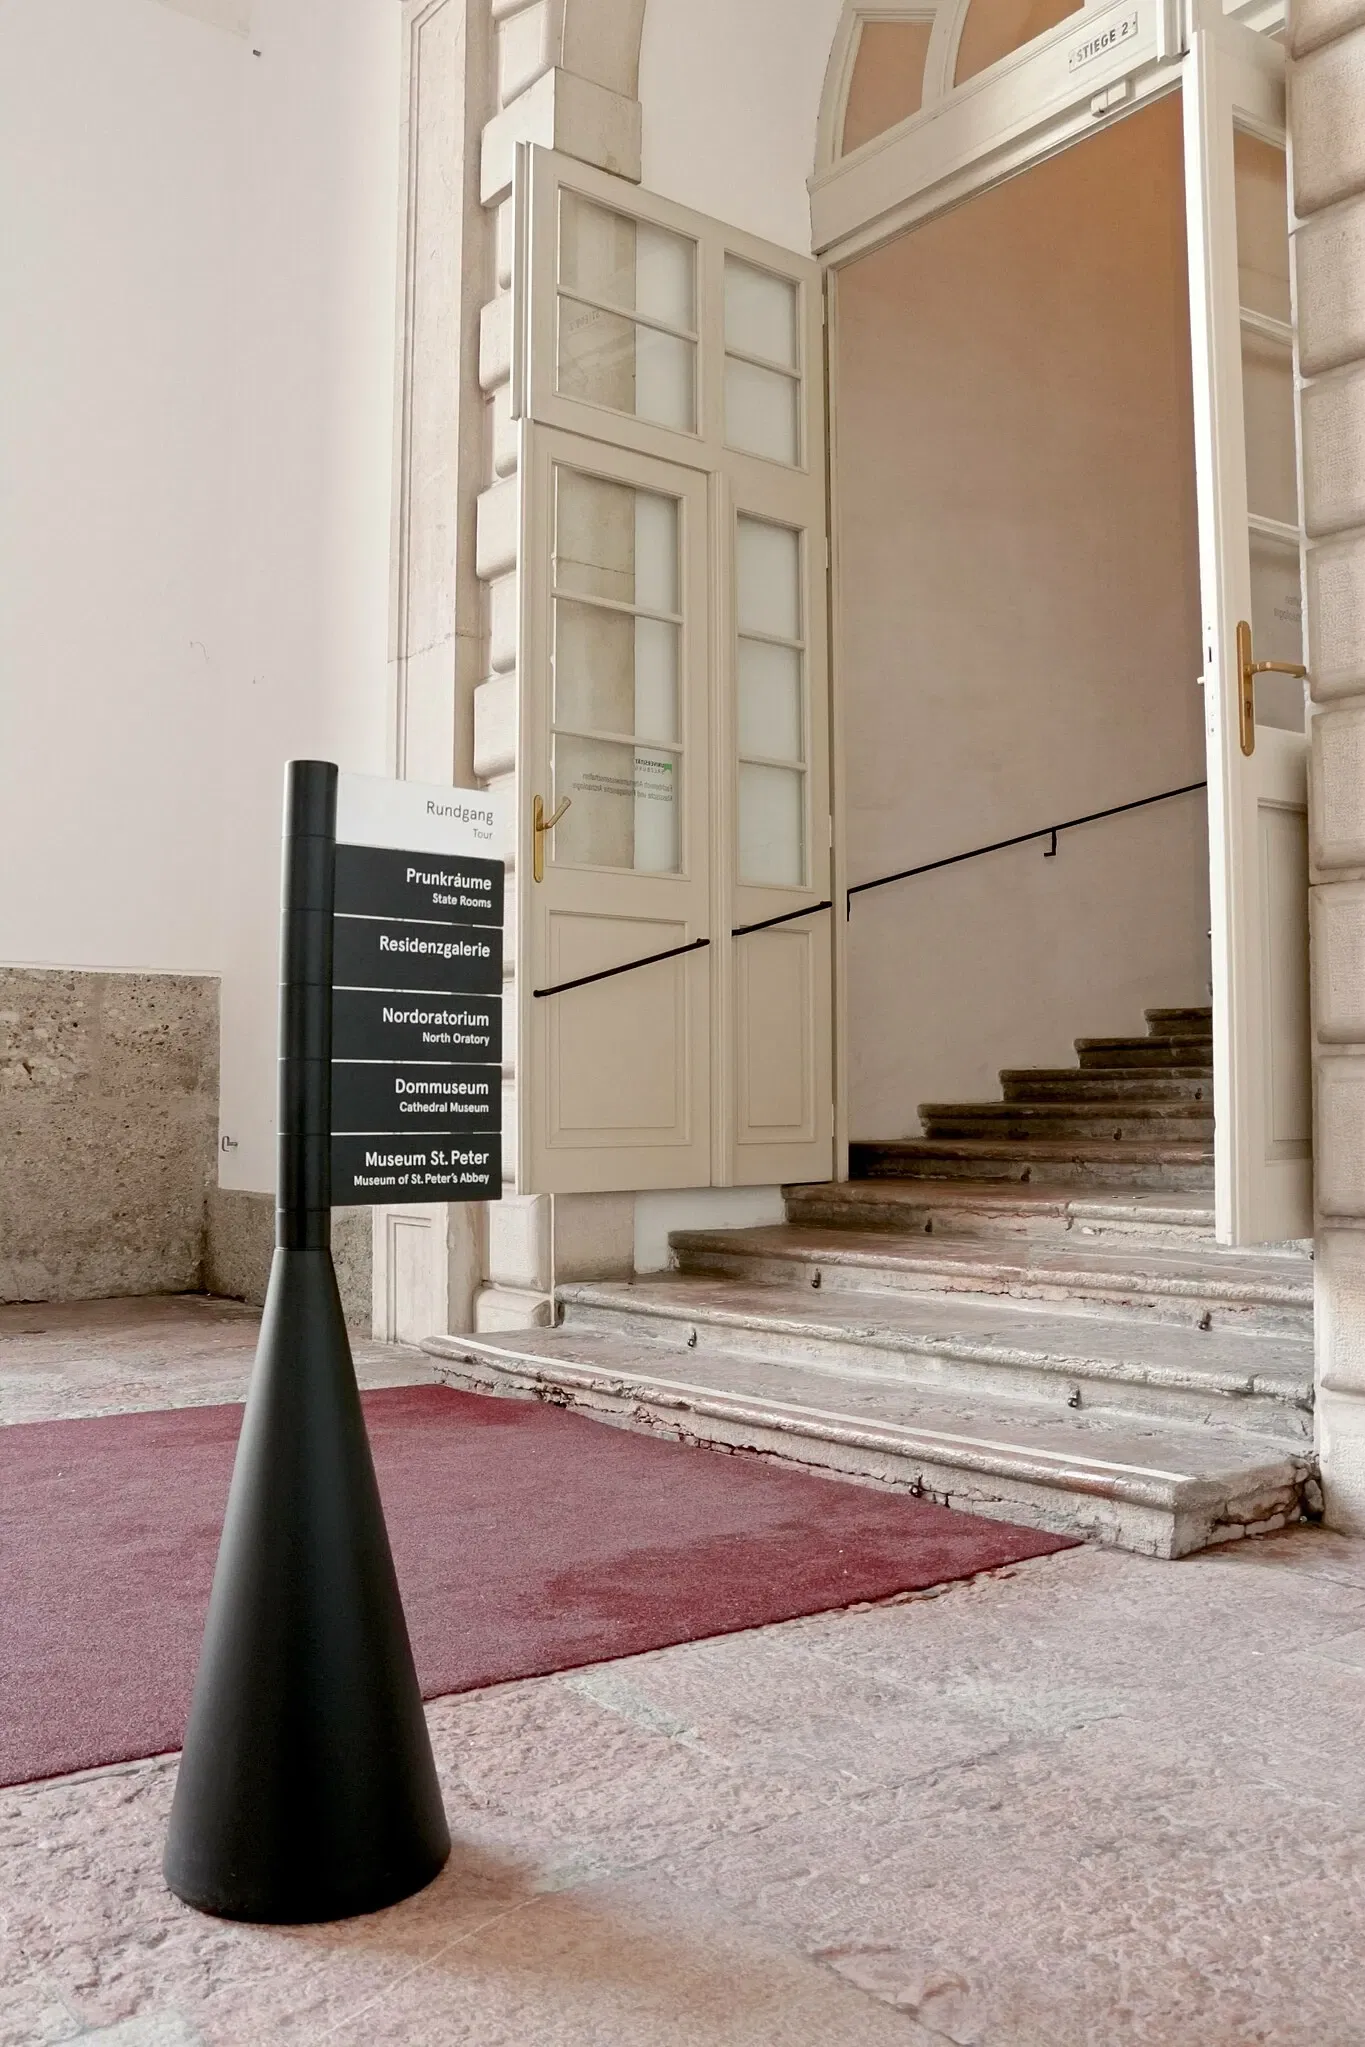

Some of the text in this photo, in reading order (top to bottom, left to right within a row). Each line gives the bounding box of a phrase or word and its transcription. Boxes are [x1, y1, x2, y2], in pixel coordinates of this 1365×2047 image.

[1076, 21, 1129, 63] STIEGE 2
[426, 800, 494, 826] Rundgang
[473, 828, 493, 840] Tour
[432, 892, 492, 909] State Rooms
[379, 935, 491, 959] Residenzgalerie
[382, 1007, 490, 1027] Nordoratorium
[422, 1032, 490, 1047] North Oratory
[395, 1078, 489, 1095] Dommuseum
[399, 1101, 489, 1113] Cathedral Museum
[365, 1150, 490, 1167] Museum St. Peter
[353, 1175, 396, 1187] Museum
[397, 1174, 410, 1185] of
[410, 1173, 424, 1185] St.
[459, 1172, 490, 1185] Abbey
